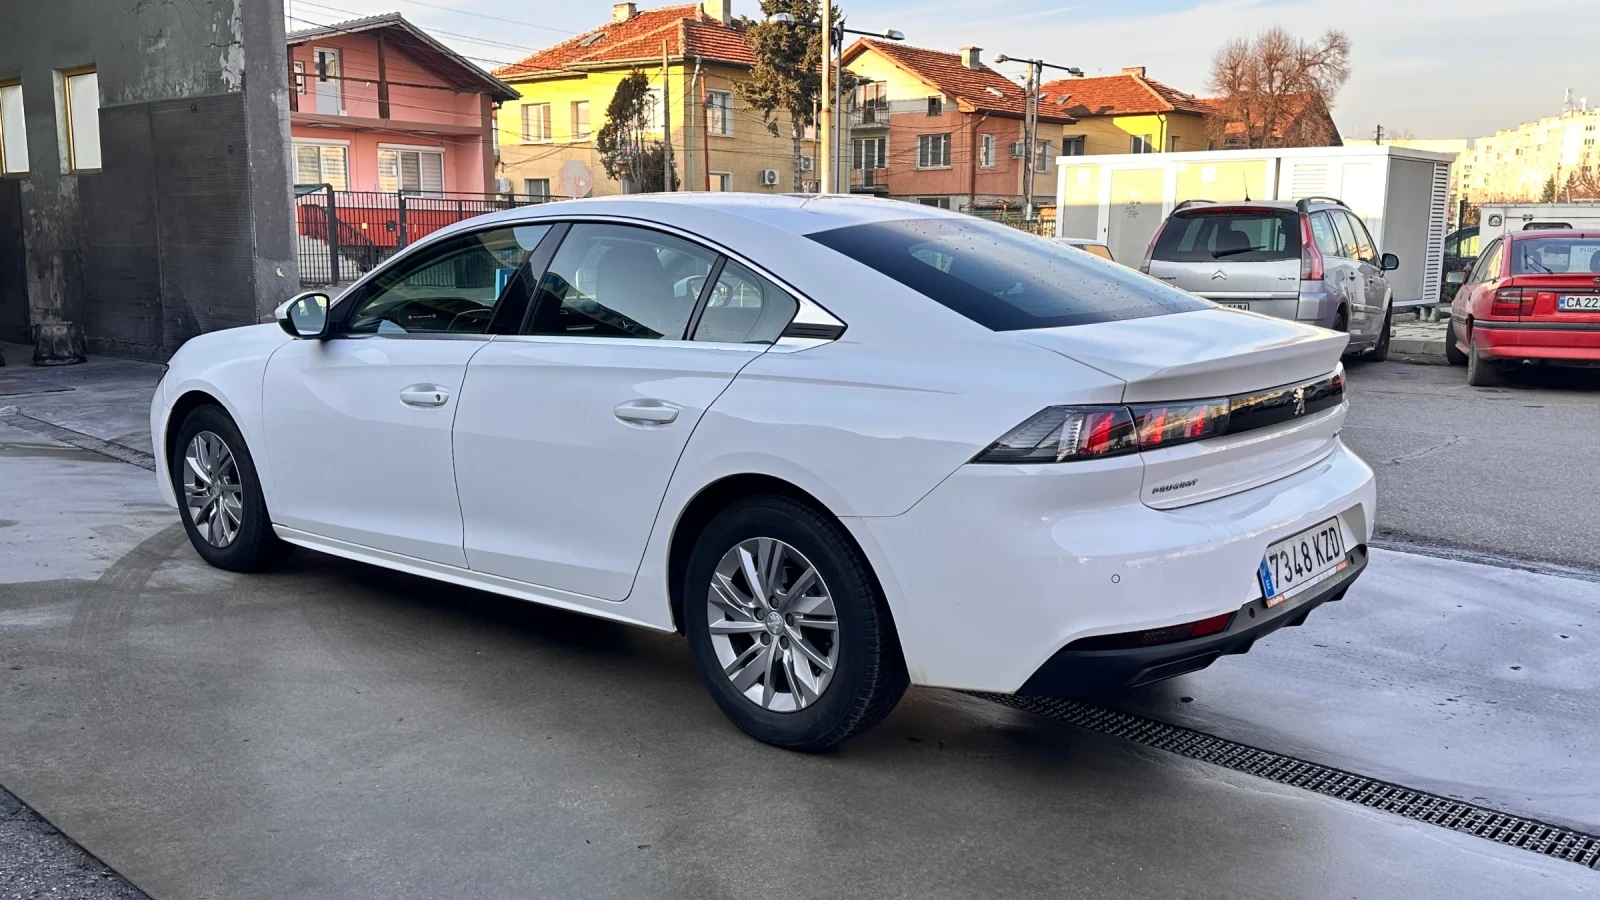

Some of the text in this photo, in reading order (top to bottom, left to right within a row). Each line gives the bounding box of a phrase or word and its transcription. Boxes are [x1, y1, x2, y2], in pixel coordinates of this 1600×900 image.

[1584, 297, 1600, 308] 22
[1152, 478, 1199, 494] PEUGEOT
[1269, 527, 1340, 589] 7348 KZD
